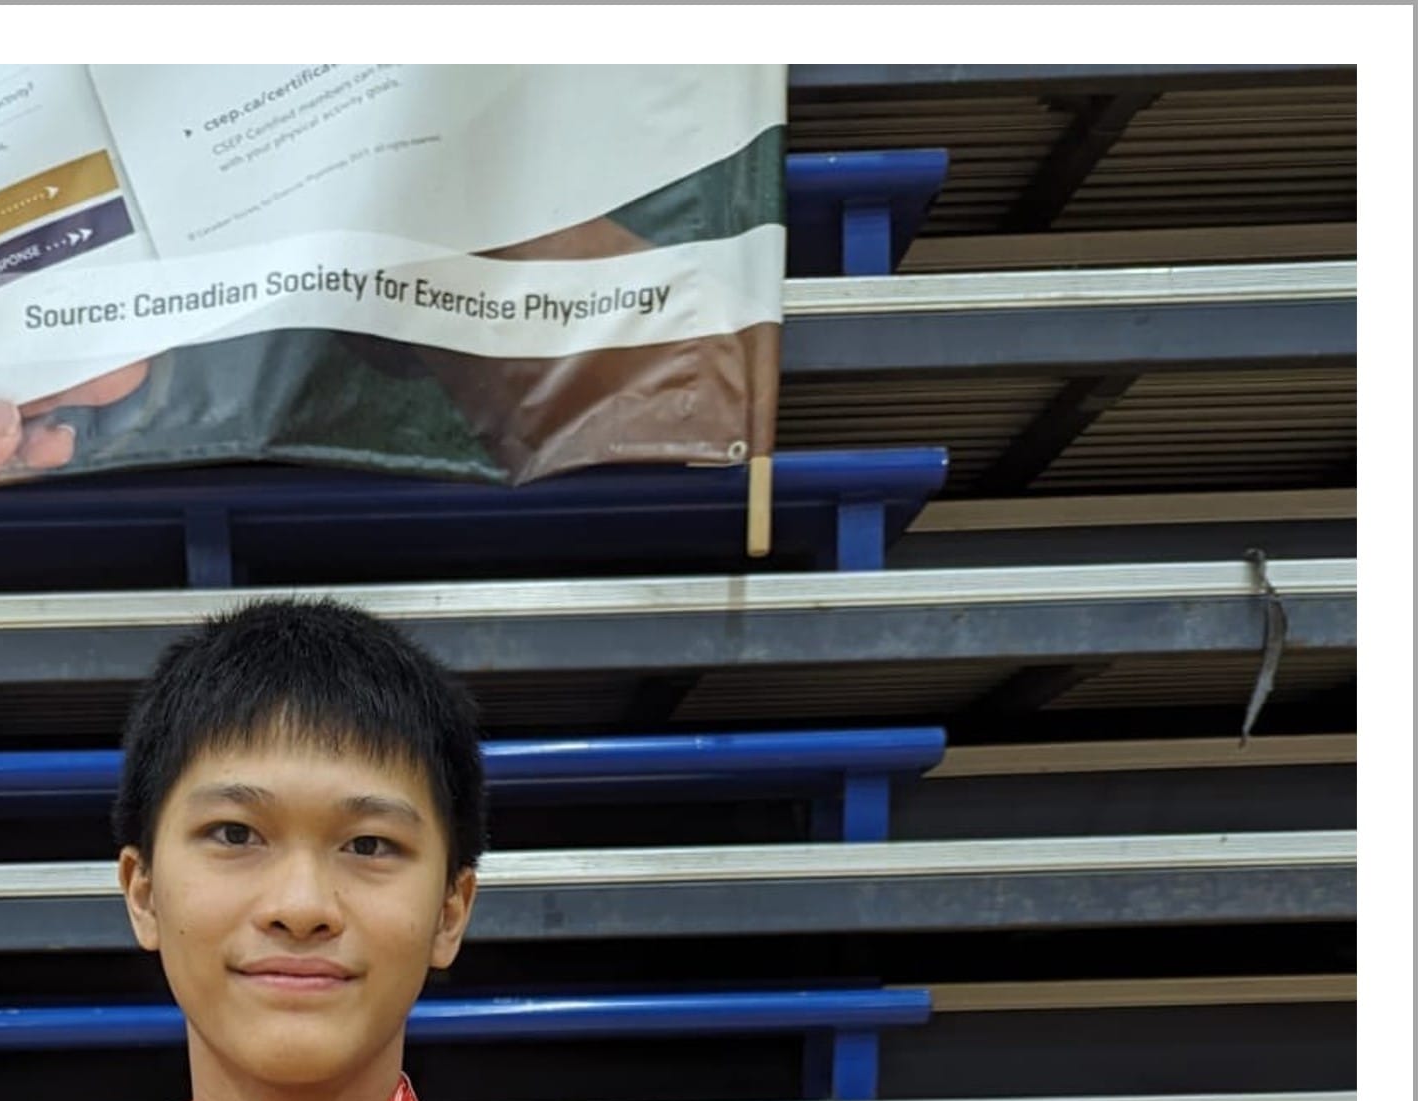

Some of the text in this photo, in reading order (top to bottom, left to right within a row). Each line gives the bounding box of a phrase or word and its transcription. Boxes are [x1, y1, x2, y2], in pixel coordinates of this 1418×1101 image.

[203, 64, 335, 132] csep.ca/certifica
[24, 264, 671, 329] Source: Canadian Society for Exercise Physiology
